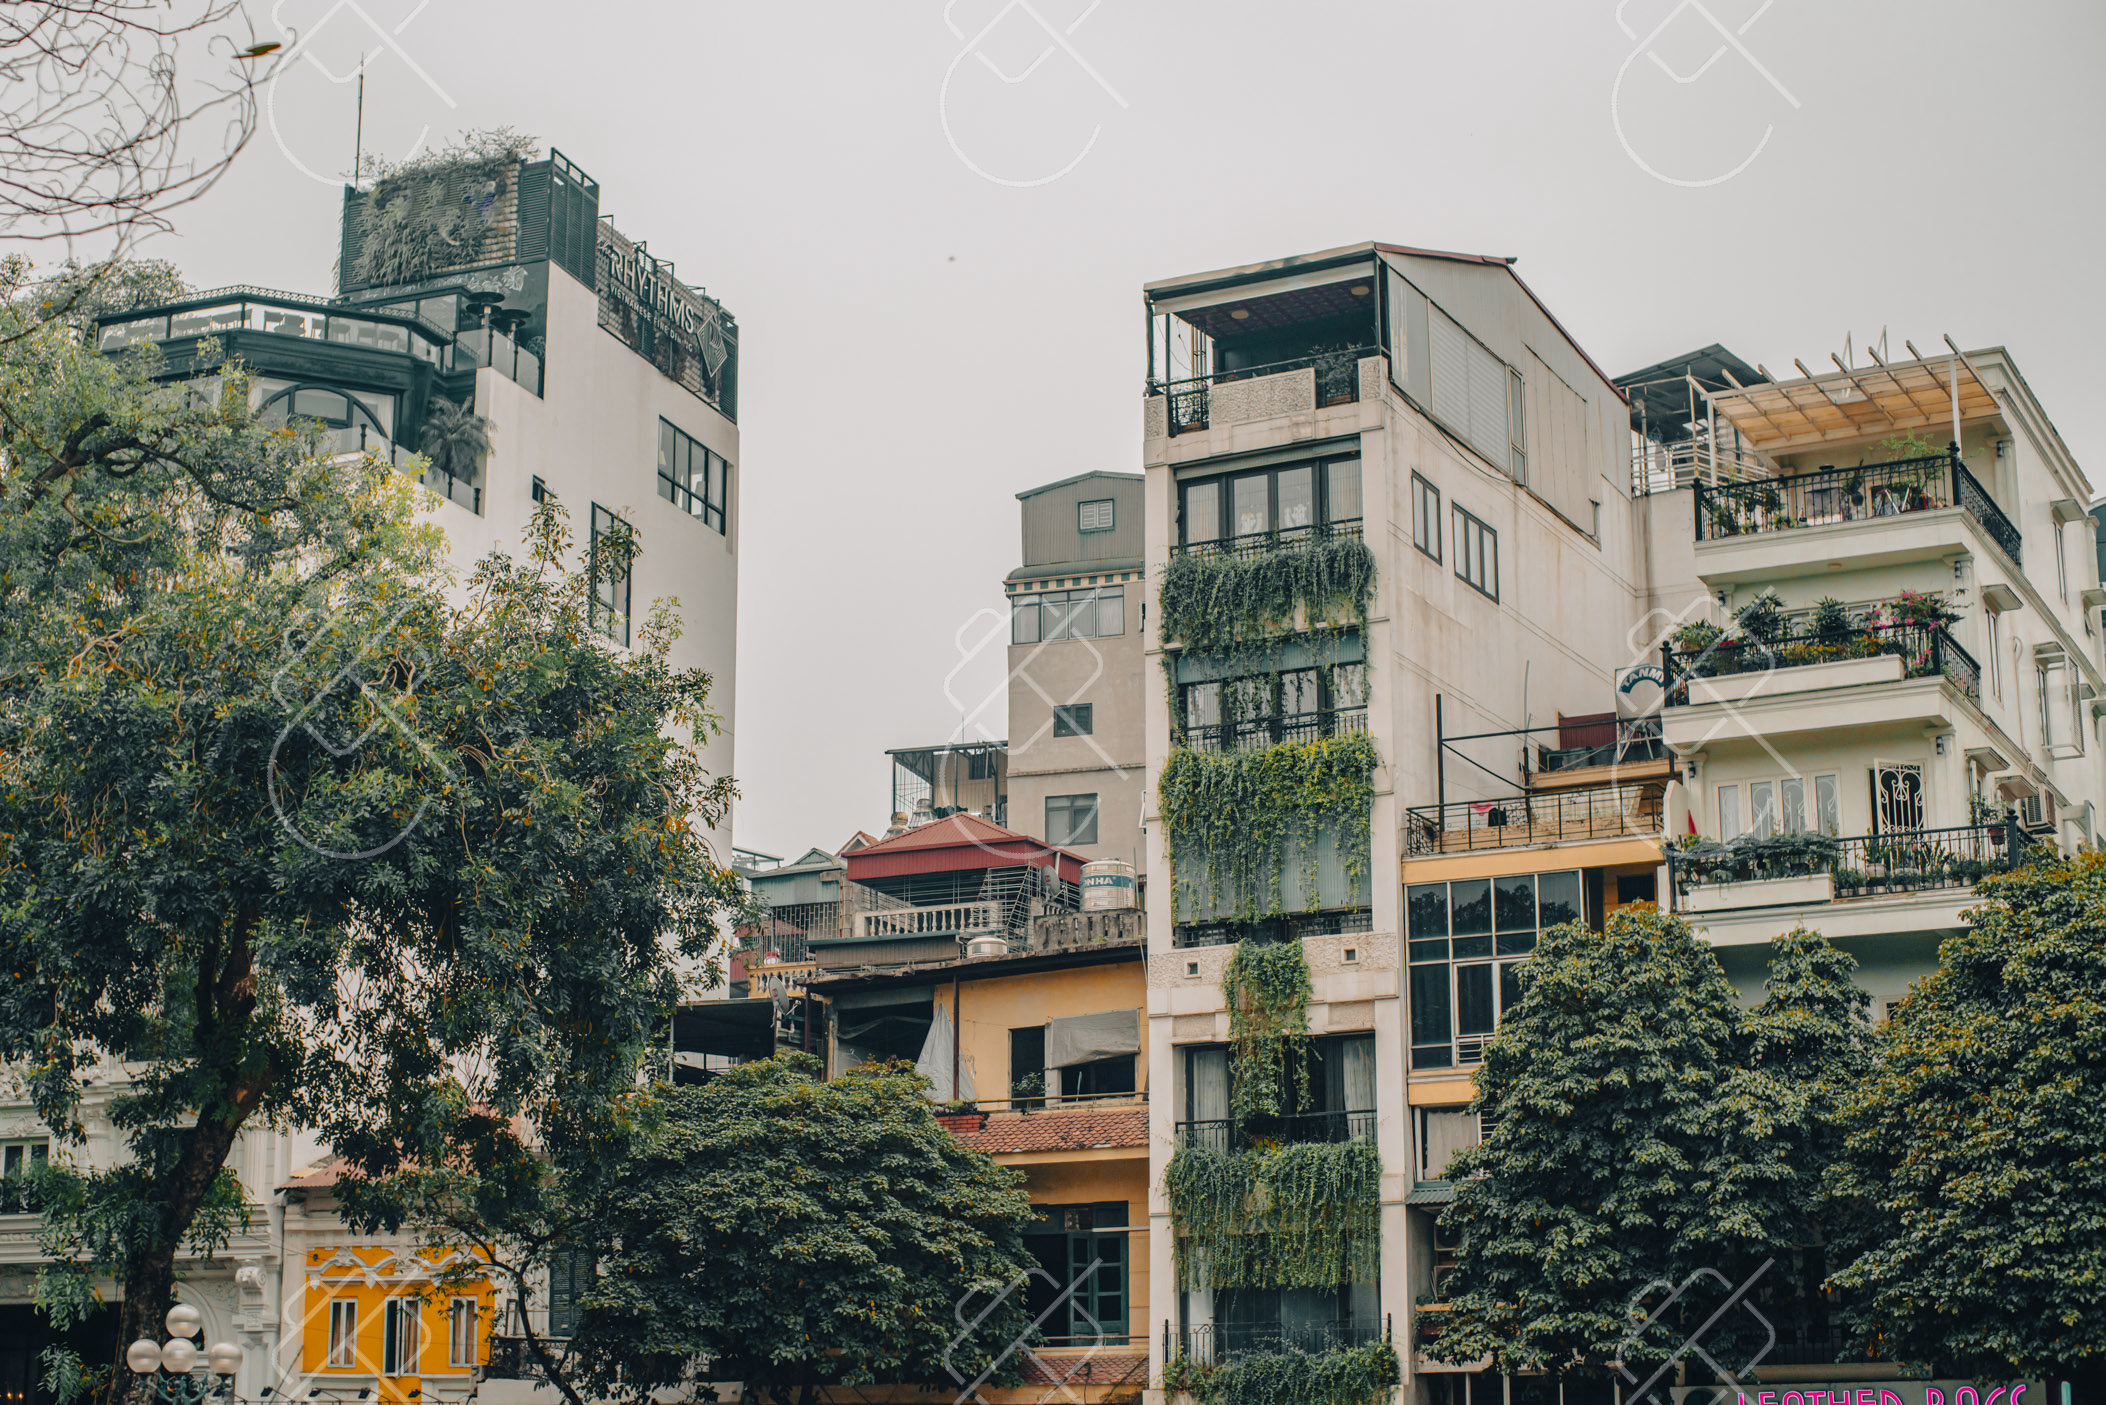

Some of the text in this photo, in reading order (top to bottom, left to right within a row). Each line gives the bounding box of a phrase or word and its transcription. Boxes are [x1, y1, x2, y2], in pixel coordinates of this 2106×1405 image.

[610, 283, 652, 322] VIETNAMESE
[653, 310, 669, 334] FINE
[611, 247, 695, 334] RHYTHMS
